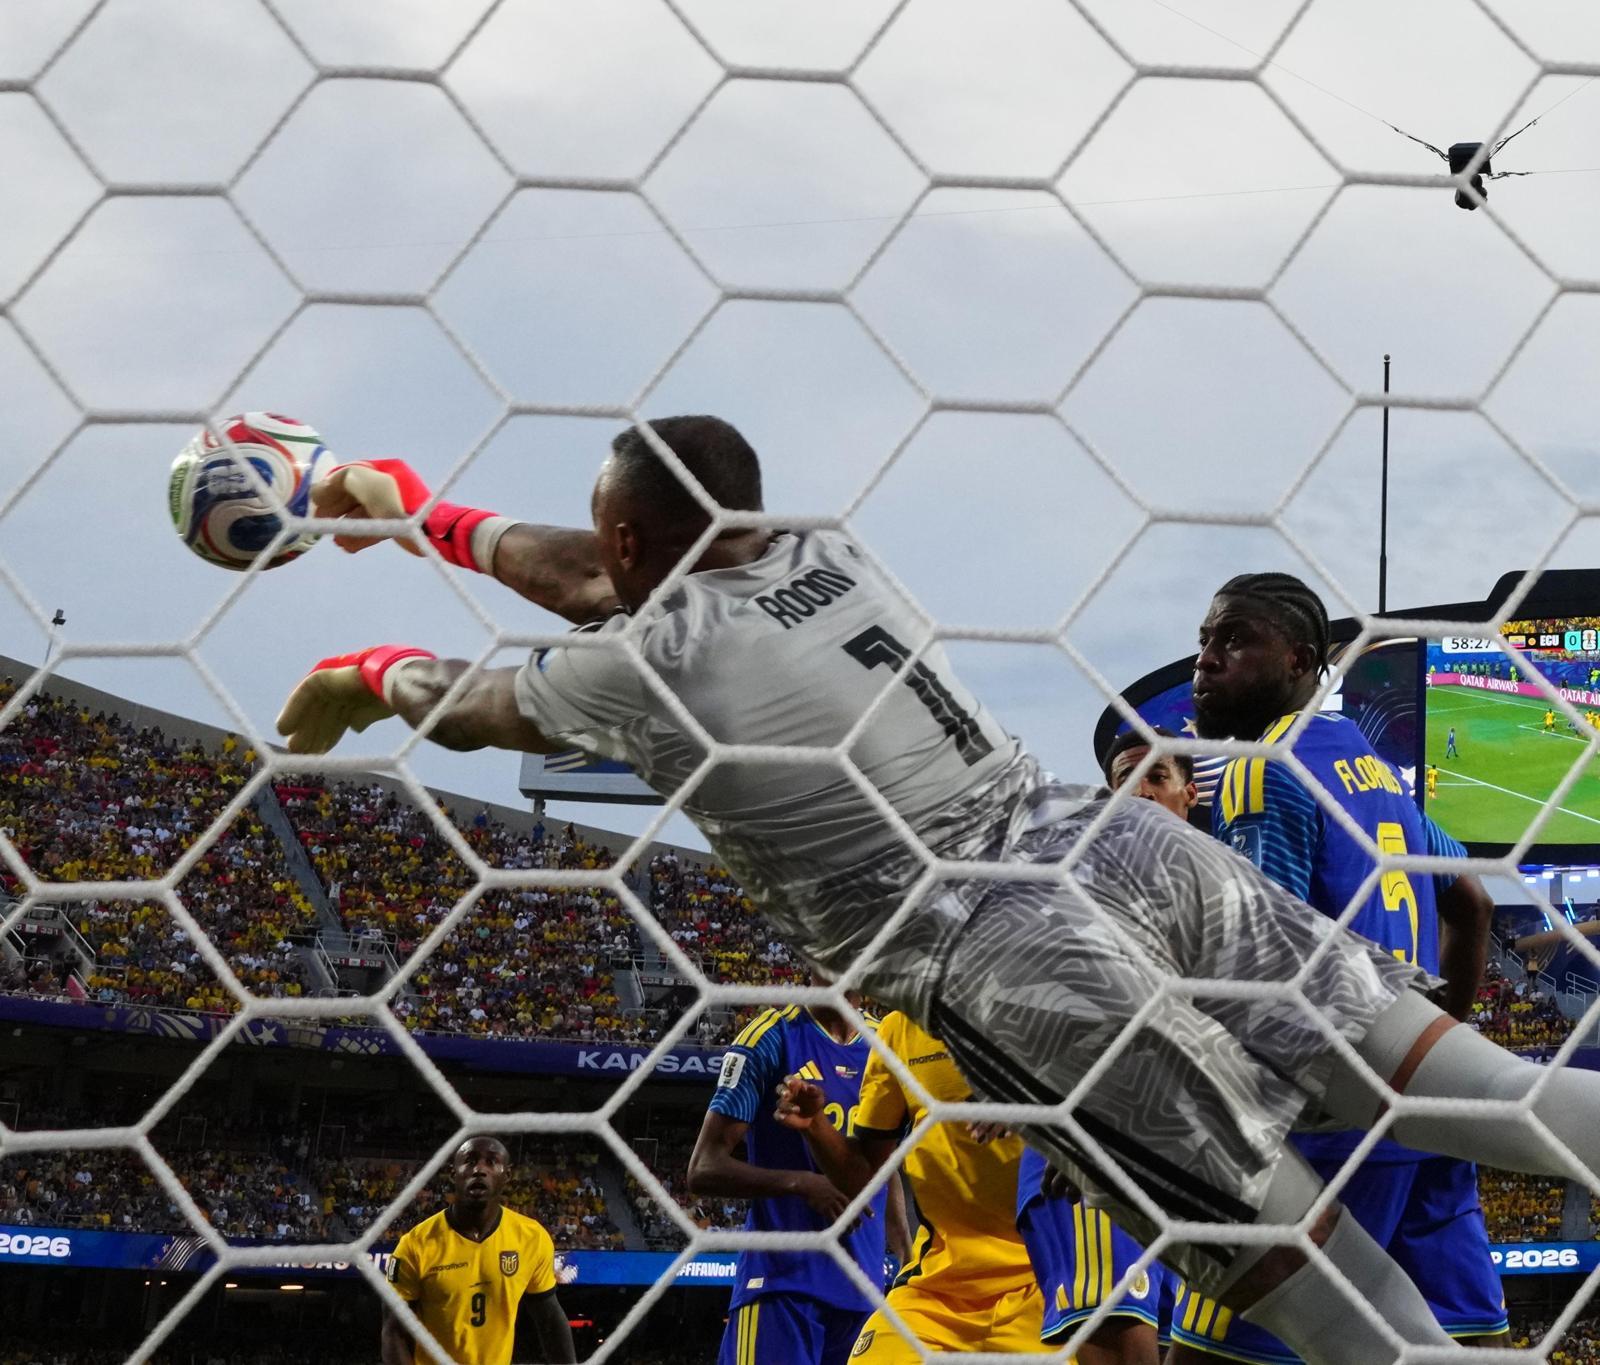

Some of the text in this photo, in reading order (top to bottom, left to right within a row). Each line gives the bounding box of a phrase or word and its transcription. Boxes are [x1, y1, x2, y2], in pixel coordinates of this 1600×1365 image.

[754, 568, 857, 630] ROOM
[1539, 634, 1577, 647] ECU 0
[1460, 674, 1519, 693] QATAR AIRWAYS
[840, 624, 995, 768] 1
[1560, 688, 1587, 704] QATAR
[1376, 822, 1419, 967] 5
[577, 1050, 724, 1074] KANSAS
[1506, 1249, 1578, 1268] 2026
[470, 1292, 486, 1328] 9
